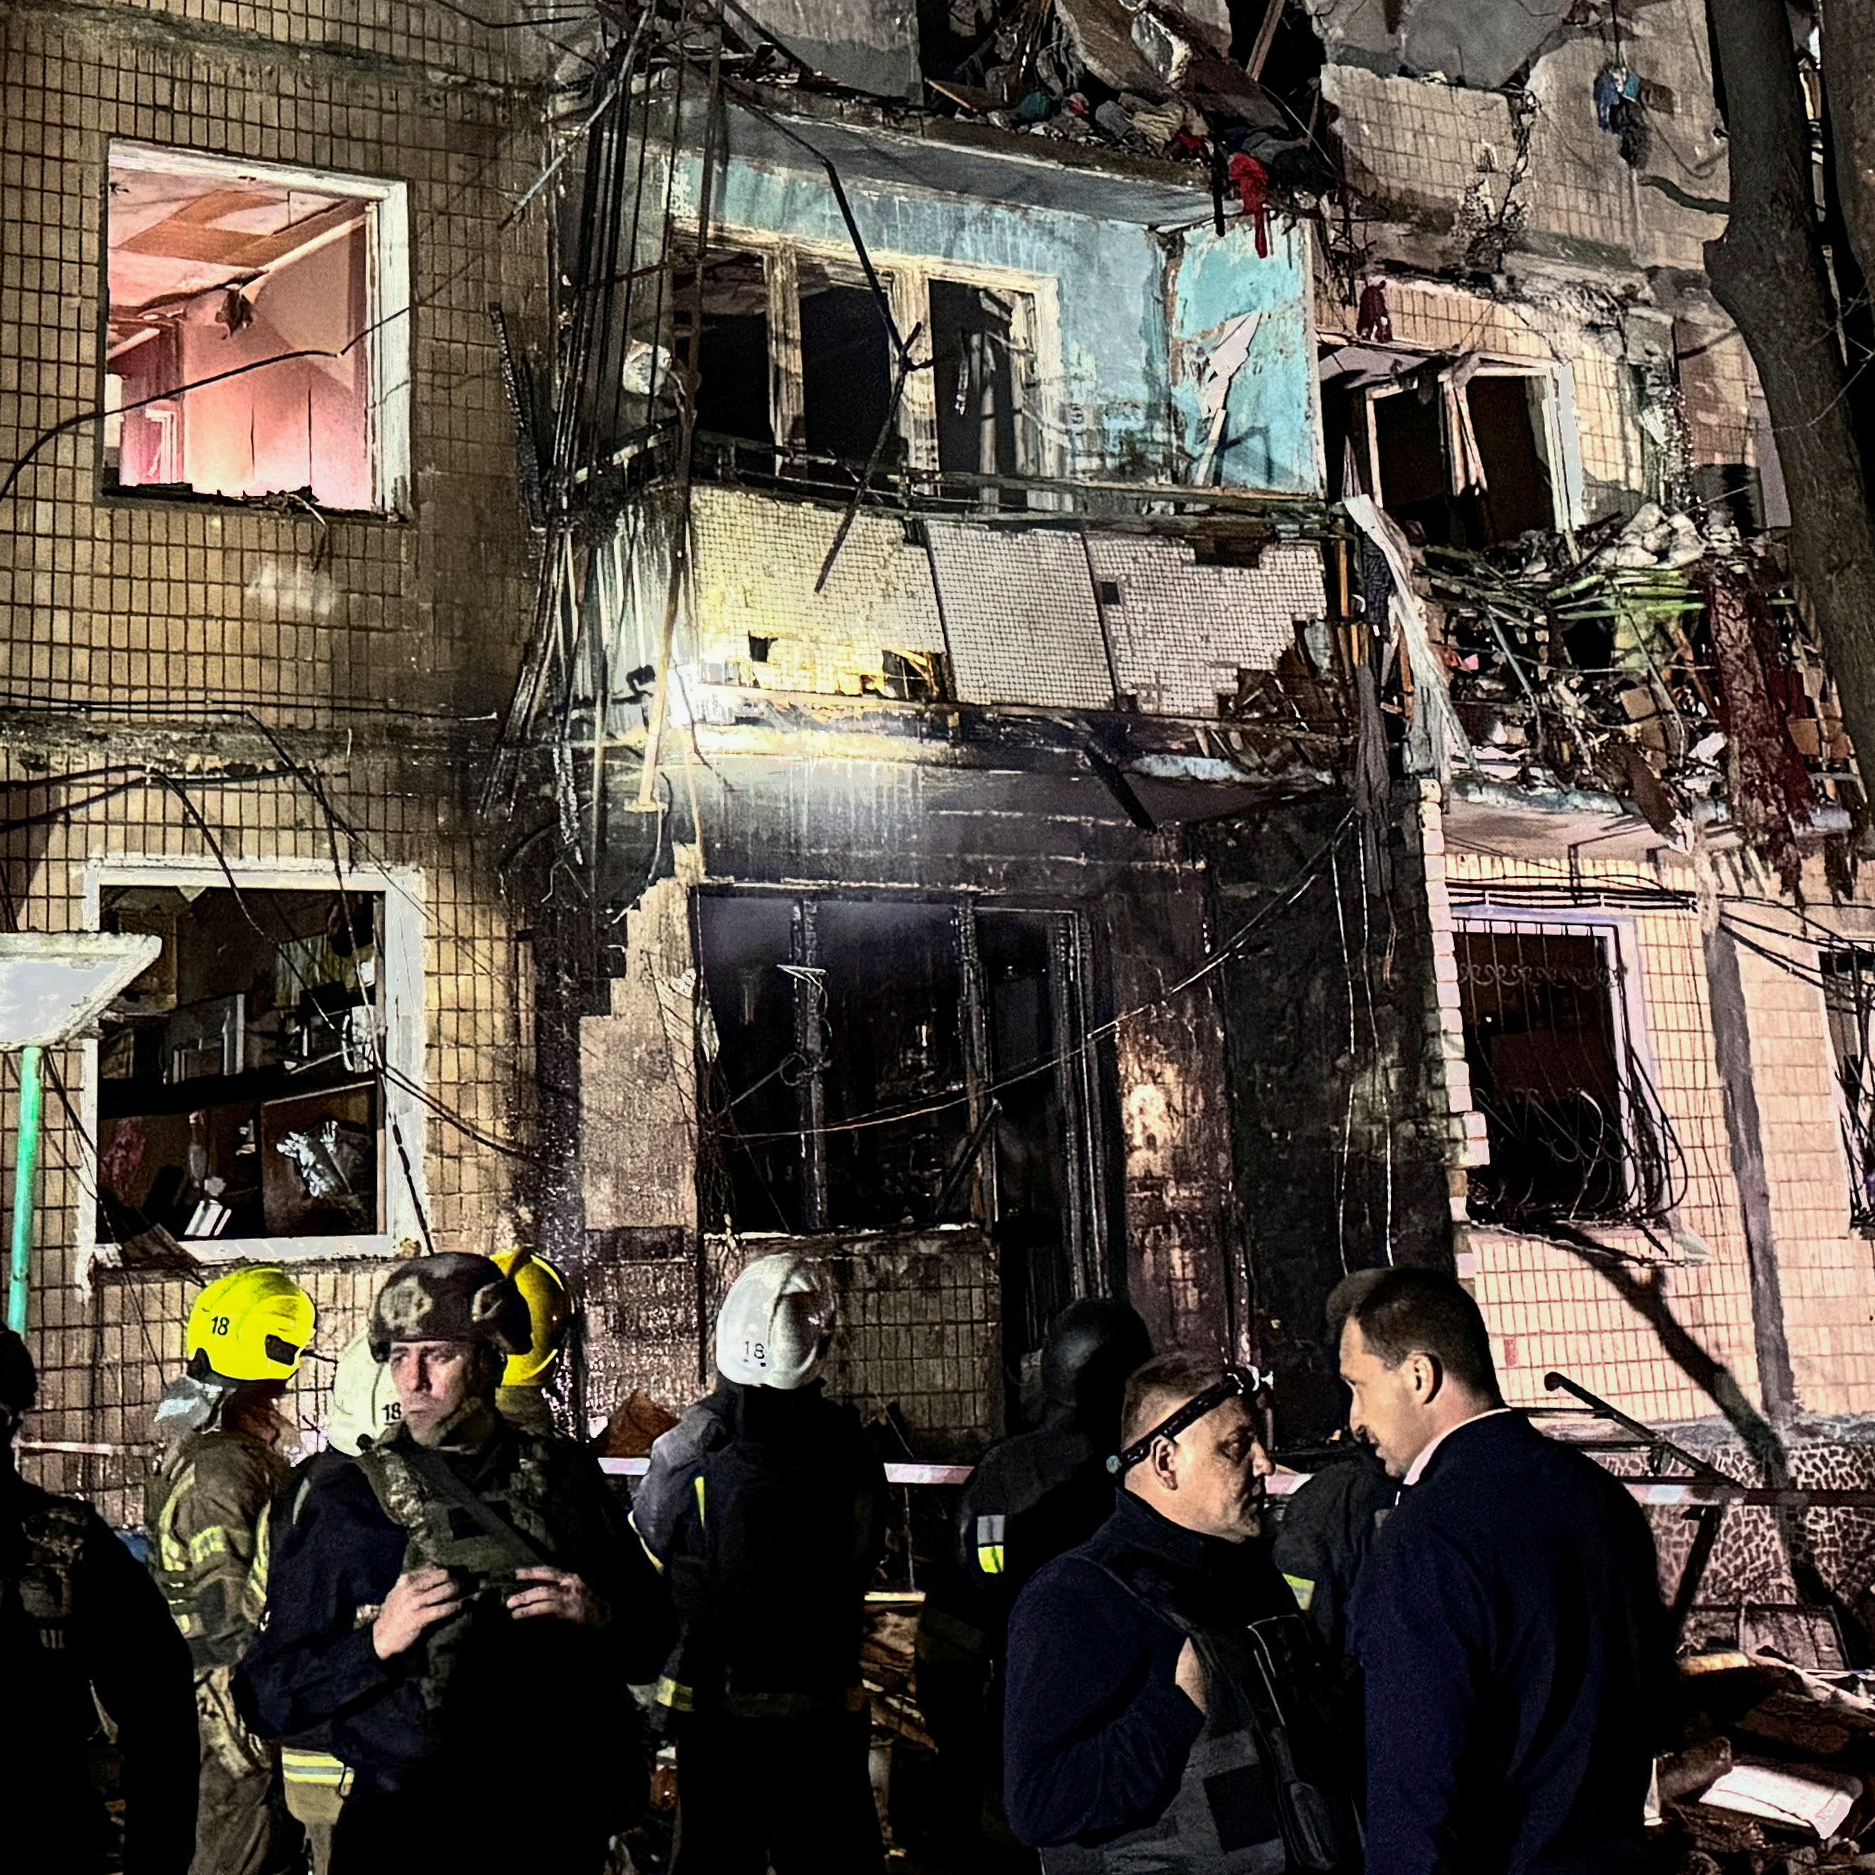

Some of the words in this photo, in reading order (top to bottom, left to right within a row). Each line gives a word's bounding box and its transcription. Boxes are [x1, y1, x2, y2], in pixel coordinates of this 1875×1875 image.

[211, 1316, 230, 1336] 18
[744, 1341, 765, 1359] 18
[381, 1401, 402, 1422] 18
